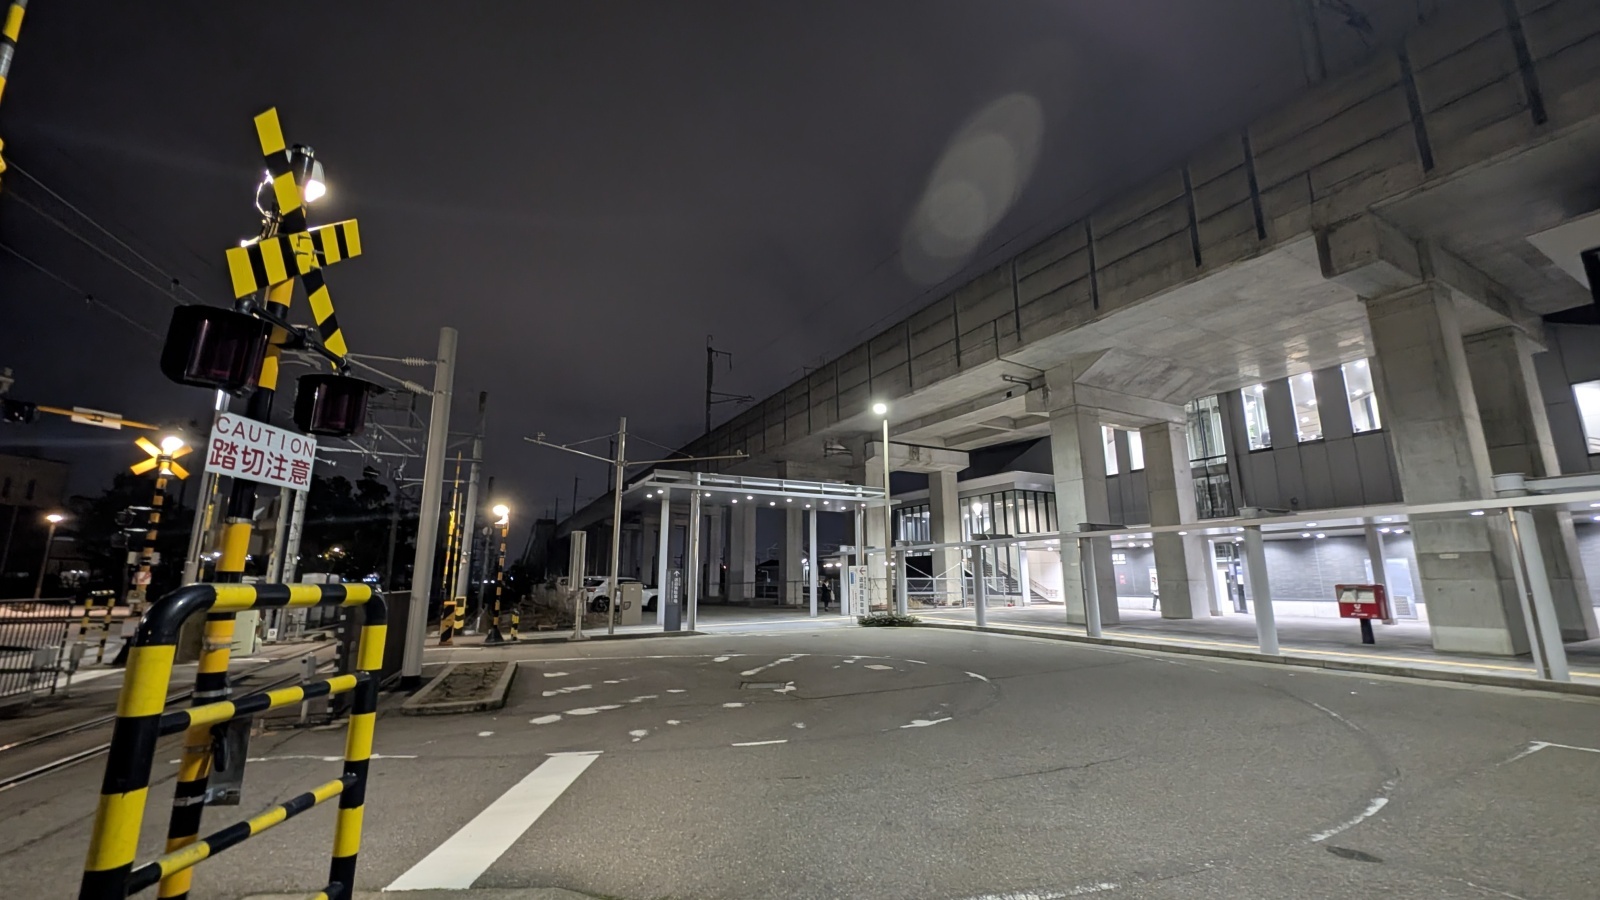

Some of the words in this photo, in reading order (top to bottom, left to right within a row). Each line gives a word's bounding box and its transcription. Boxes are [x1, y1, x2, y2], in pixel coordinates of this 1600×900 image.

[216, 416, 314, 458] CAUTION
[209, 438, 310, 486] 踏切注意
